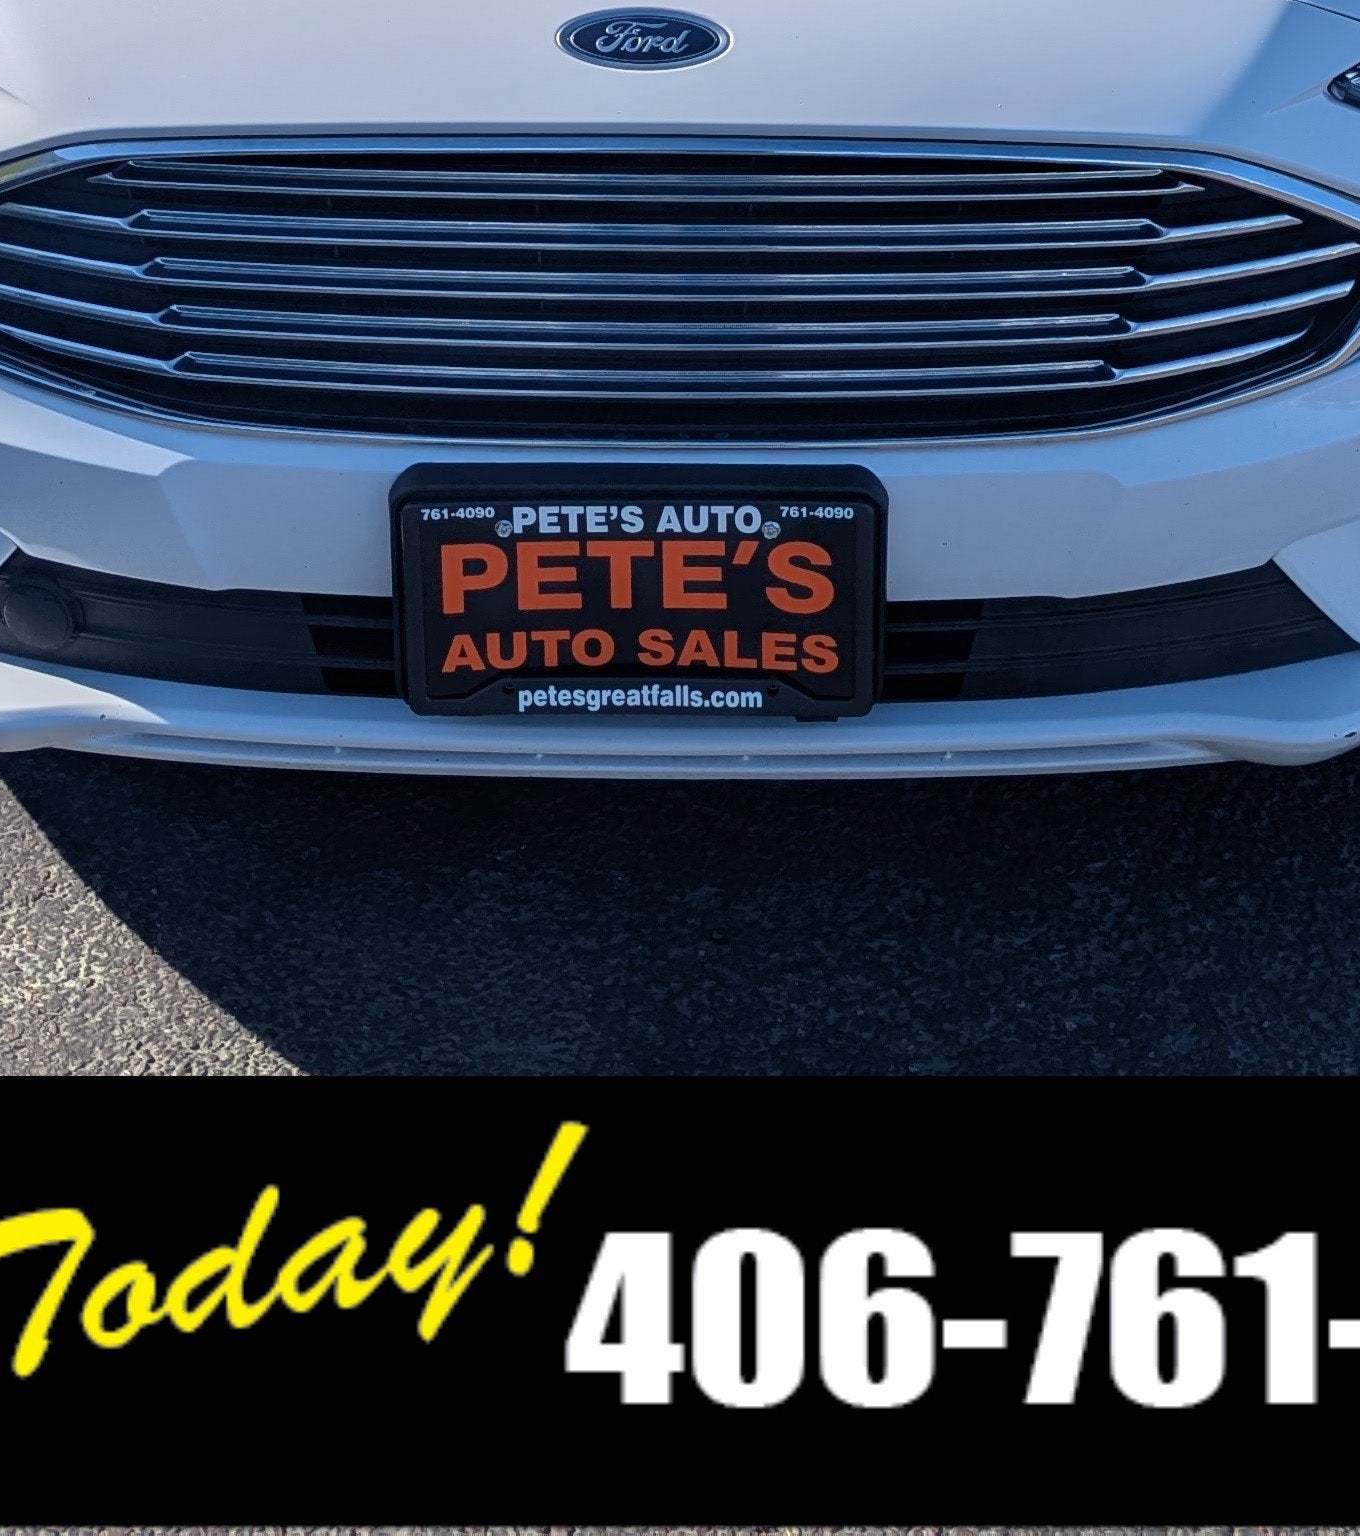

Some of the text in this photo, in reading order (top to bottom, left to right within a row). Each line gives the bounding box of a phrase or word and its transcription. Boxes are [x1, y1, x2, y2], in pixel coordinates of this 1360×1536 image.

[595, 21, 692, 54] Ford
[420, 506, 495, 521] 761-4090
[512, 505, 762, 534] PETE'S AUTO
[779, 506, 854, 520] 761-4090
[441, 540, 835, 614] PETE'S
[442, 629, 839, 673] AUTO SALES
[518, 684, 763, 712] petesgreatfalls.com
